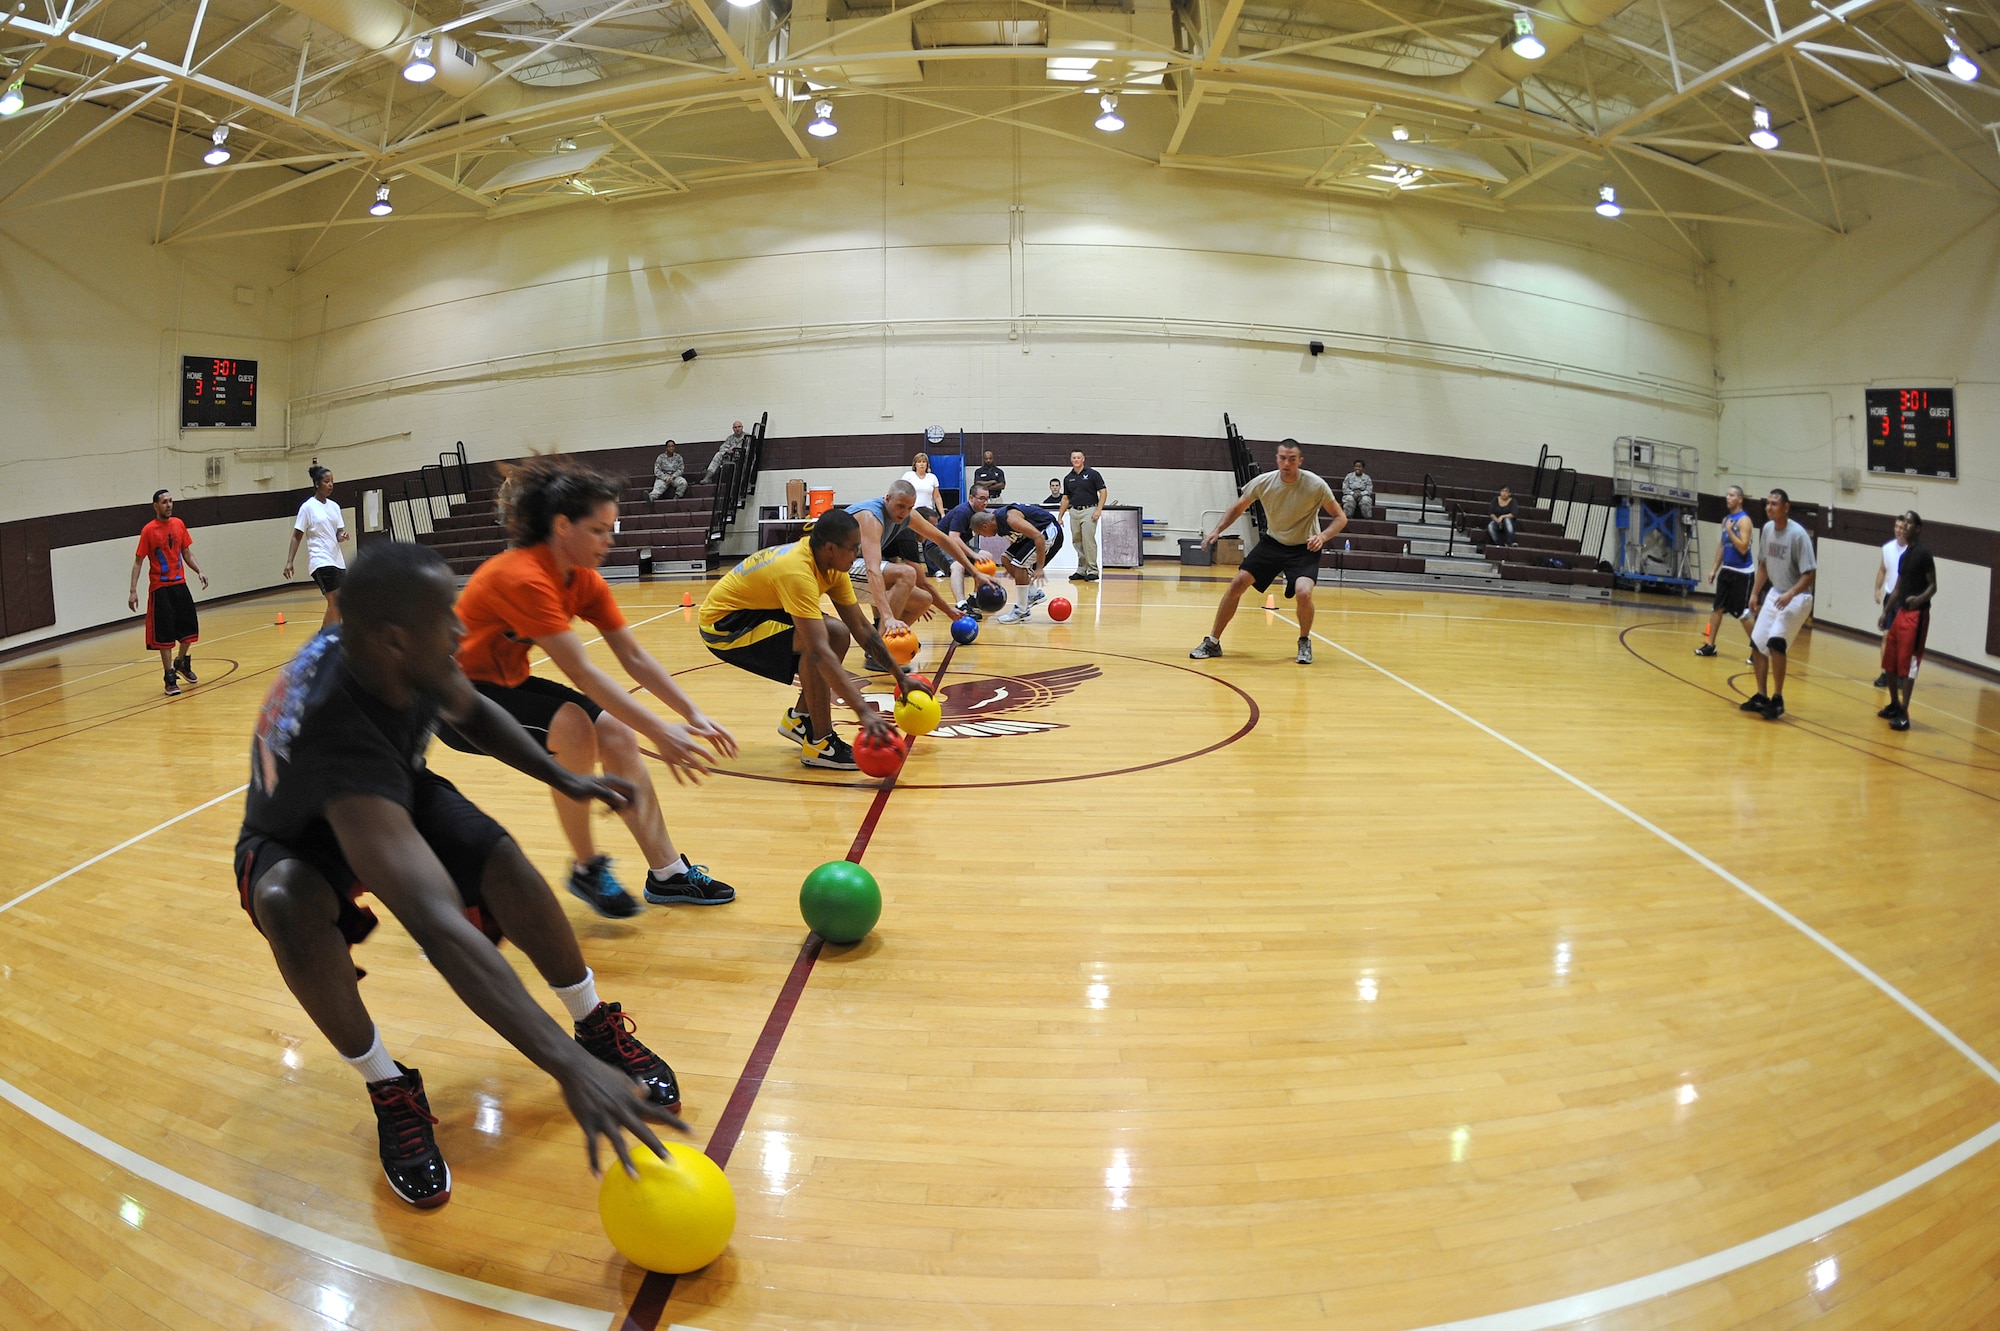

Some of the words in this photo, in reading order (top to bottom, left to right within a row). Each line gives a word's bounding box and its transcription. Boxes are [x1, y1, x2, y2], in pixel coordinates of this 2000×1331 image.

[212, 360, 237, 376] 3:01
[195, 380, 203, 396] 3
[1900, 390, 1928, 410] 3:01
[1870, 407, 1888, 416] HOME
[1929, 408, 1950, 417] GUEST
[1882, 416, 1890, 436] 3
